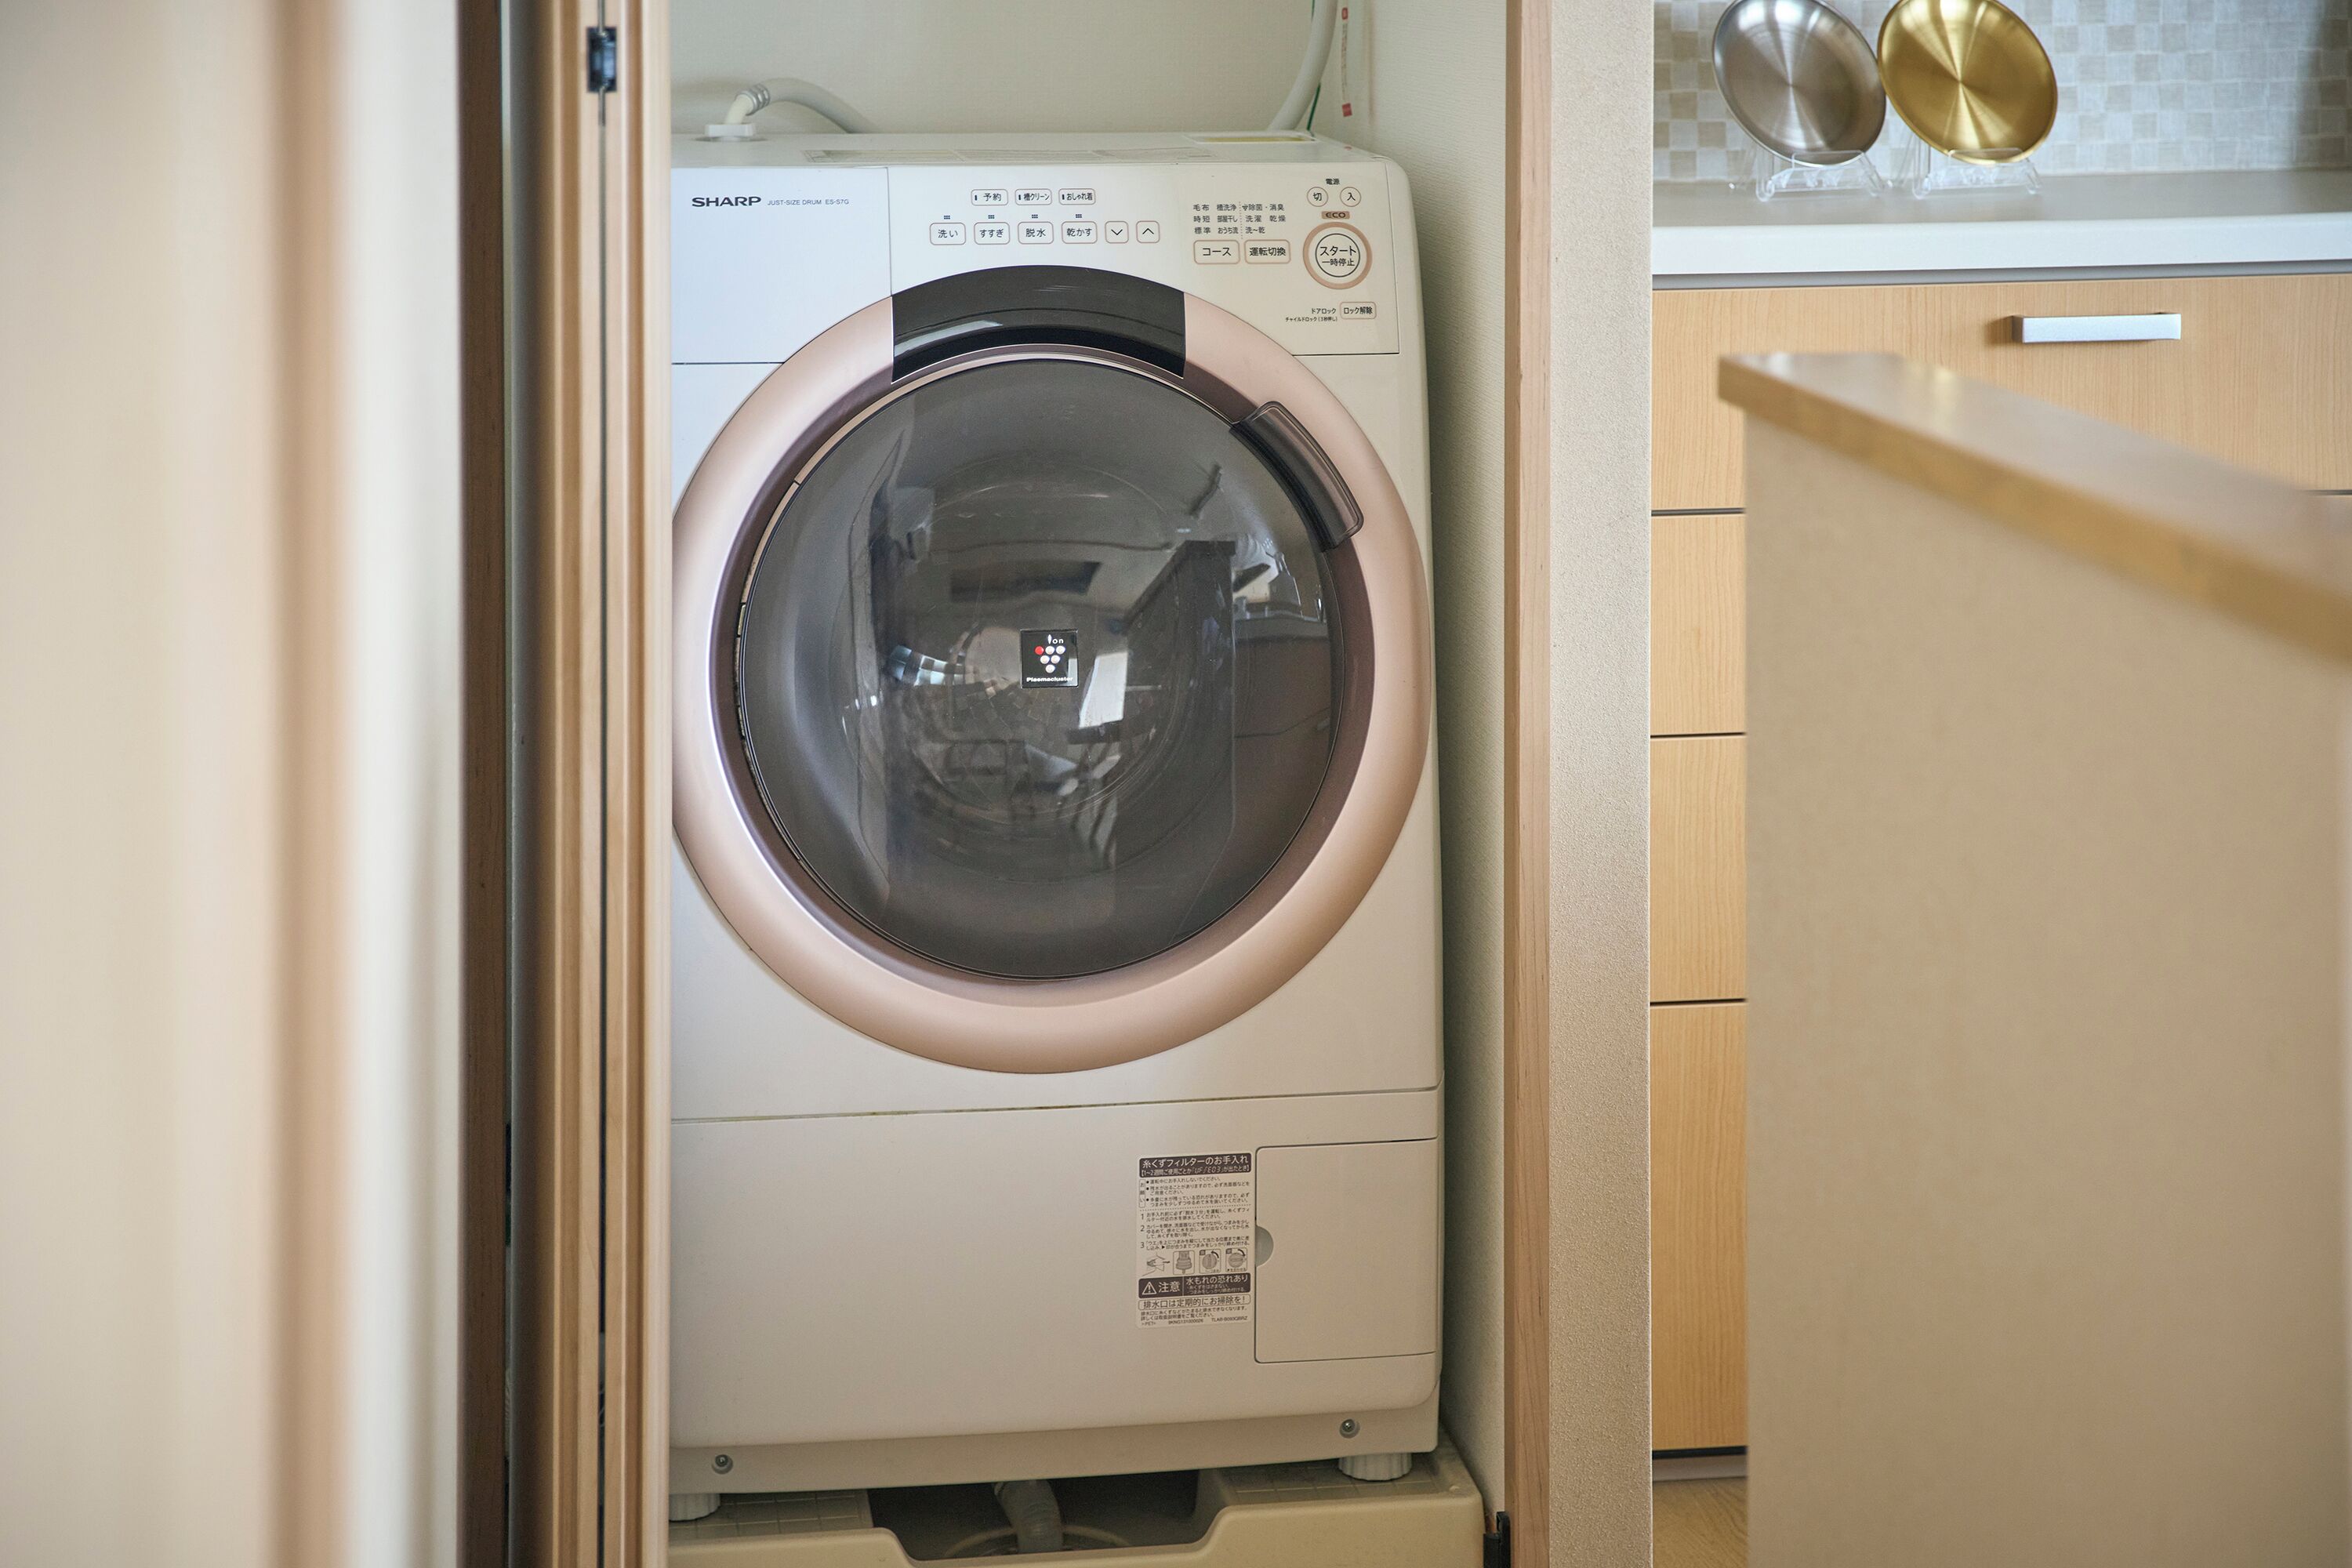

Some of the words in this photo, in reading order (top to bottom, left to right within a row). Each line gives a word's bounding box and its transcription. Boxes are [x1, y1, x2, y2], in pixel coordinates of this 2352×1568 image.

[983, 193, 1002, 201] 予約
[1023, 192, 1050, 201] 槽クリーン
[1066, 192, 1093, 201] おしゃれ着
[1312, 192, 1323, 201] 切
[1347, 192, 1356, 201] 入
[691, 196, 762, 207] SHARP
[1193, 215, 1210, 223] 時短
[1269, 214, 1287, 223] 乾燥
[938, 229, 959, 238] 洗い
[979, 228, 1004, 238] すすぎ
[1025, 227, 1047, 238] 脱水
[1066, 227, 1092, 238] 乾かす
[1202, 247, 1232, 256] コース
[1249, 247, 1287, 256] 運転切換
[1319, 245, 1356, 256] スタート
[1322, 258, 1356, 267] 一時停止
[1343, 307, 1373, 315] ロック解除
[1142, 1155, 1248, 1168] 糸くずフィルターのお手入れ
[1185, 1275, 1248, 1285] 水もれの恐れあり
[1158, 1281, 1181, 1292] 注意
[1143, 1295, 1245, 1309] 排水口は定期的にお掃除を!
